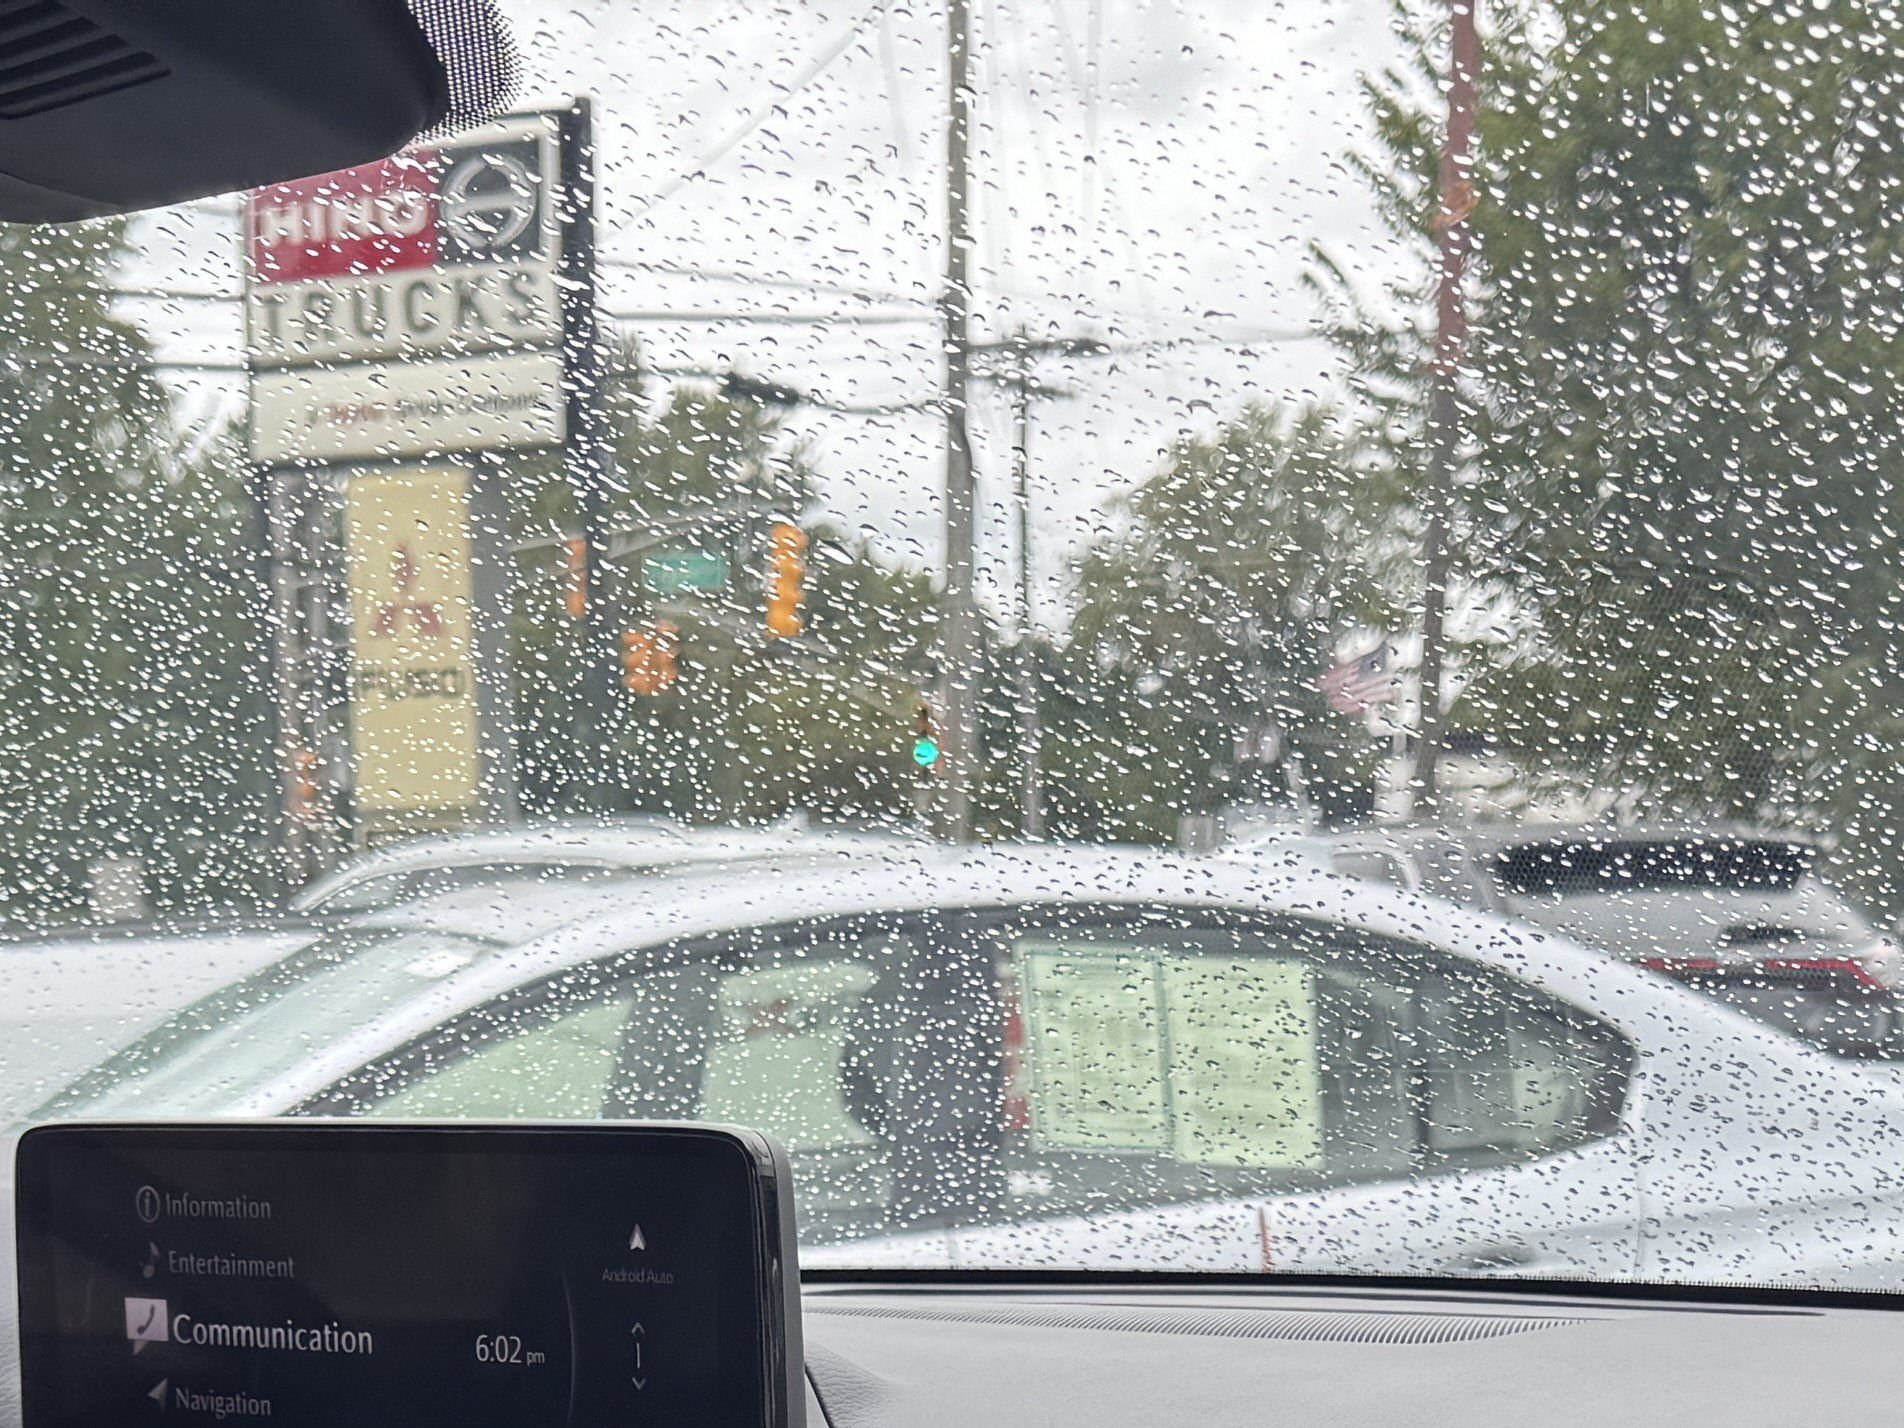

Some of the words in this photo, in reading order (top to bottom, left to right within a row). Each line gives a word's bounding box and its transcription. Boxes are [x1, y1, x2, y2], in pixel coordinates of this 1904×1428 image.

[261, 274, 541, 350] TRUCKS
[165, 1192, 272, 1219] Information
[168, 1250, 295, 1278] Entertainment
[602, 1268, 645, 1283] Android
[647, 1269, 674, 1284] Auto
[173, 1313, 373, 1354] Communication
[476, 1334, 522, 1364] 6:02
[526, 1351, 546, 1367] pm
[175, 1387, 272, 1420] Navigation
